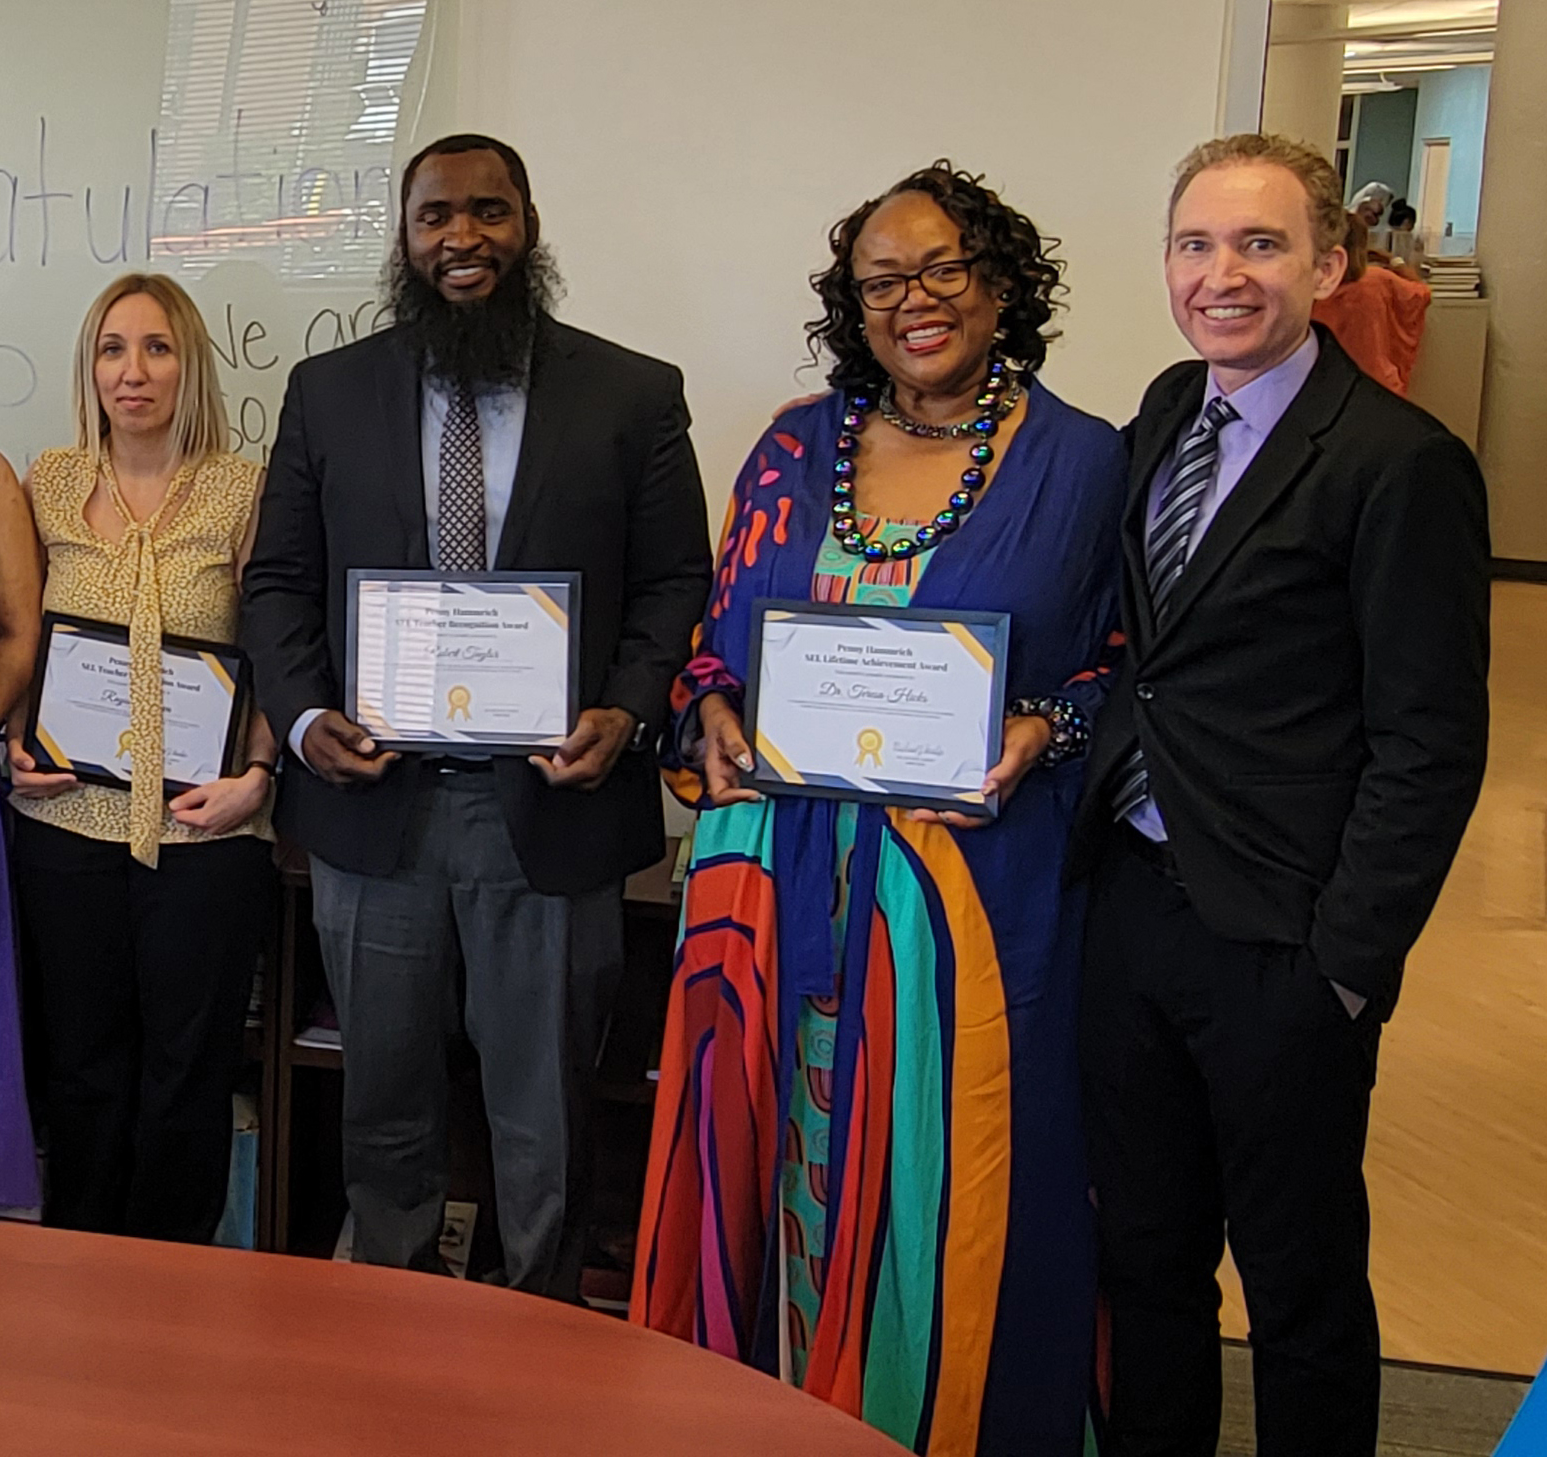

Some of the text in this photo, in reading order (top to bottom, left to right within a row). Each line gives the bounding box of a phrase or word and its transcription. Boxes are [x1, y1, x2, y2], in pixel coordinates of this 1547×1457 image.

[823, 654, 858, 666] Lifetime
[861, 657, 916, 670] Achievement
[919, 661, 947, 672] Award
